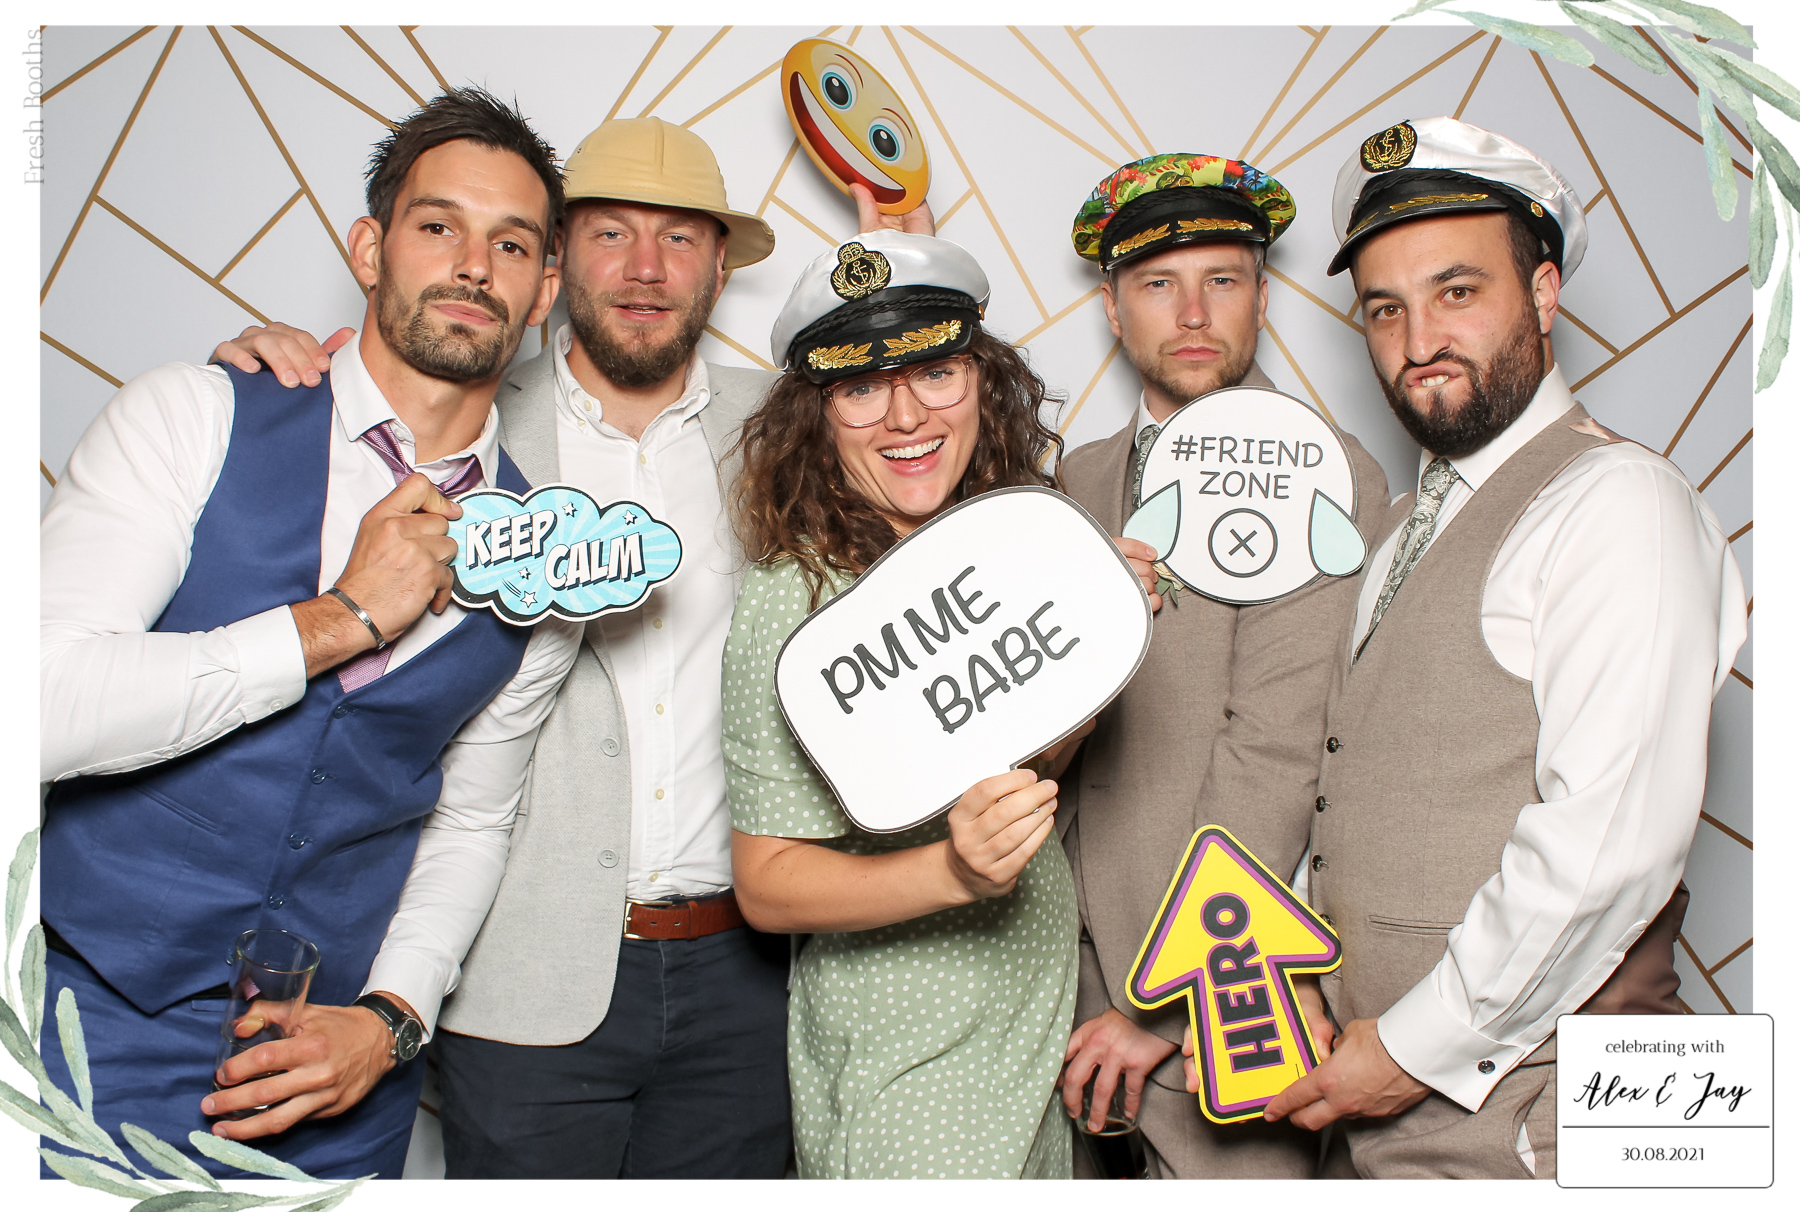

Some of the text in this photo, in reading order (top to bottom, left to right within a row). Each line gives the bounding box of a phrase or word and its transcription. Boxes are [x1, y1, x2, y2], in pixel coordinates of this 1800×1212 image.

[1170, 434, 1324, 468] #FRIEND
[1198, 470, 1291, 499] ZONE
[465, 509, 558, 570] KEEP
[544, 531, 646, 591] CALM
[820, 565, 1001, 715] PM ME
[922, 600, 1080, 734] BABE
[1200, 891, 1285, 1073] HERO
